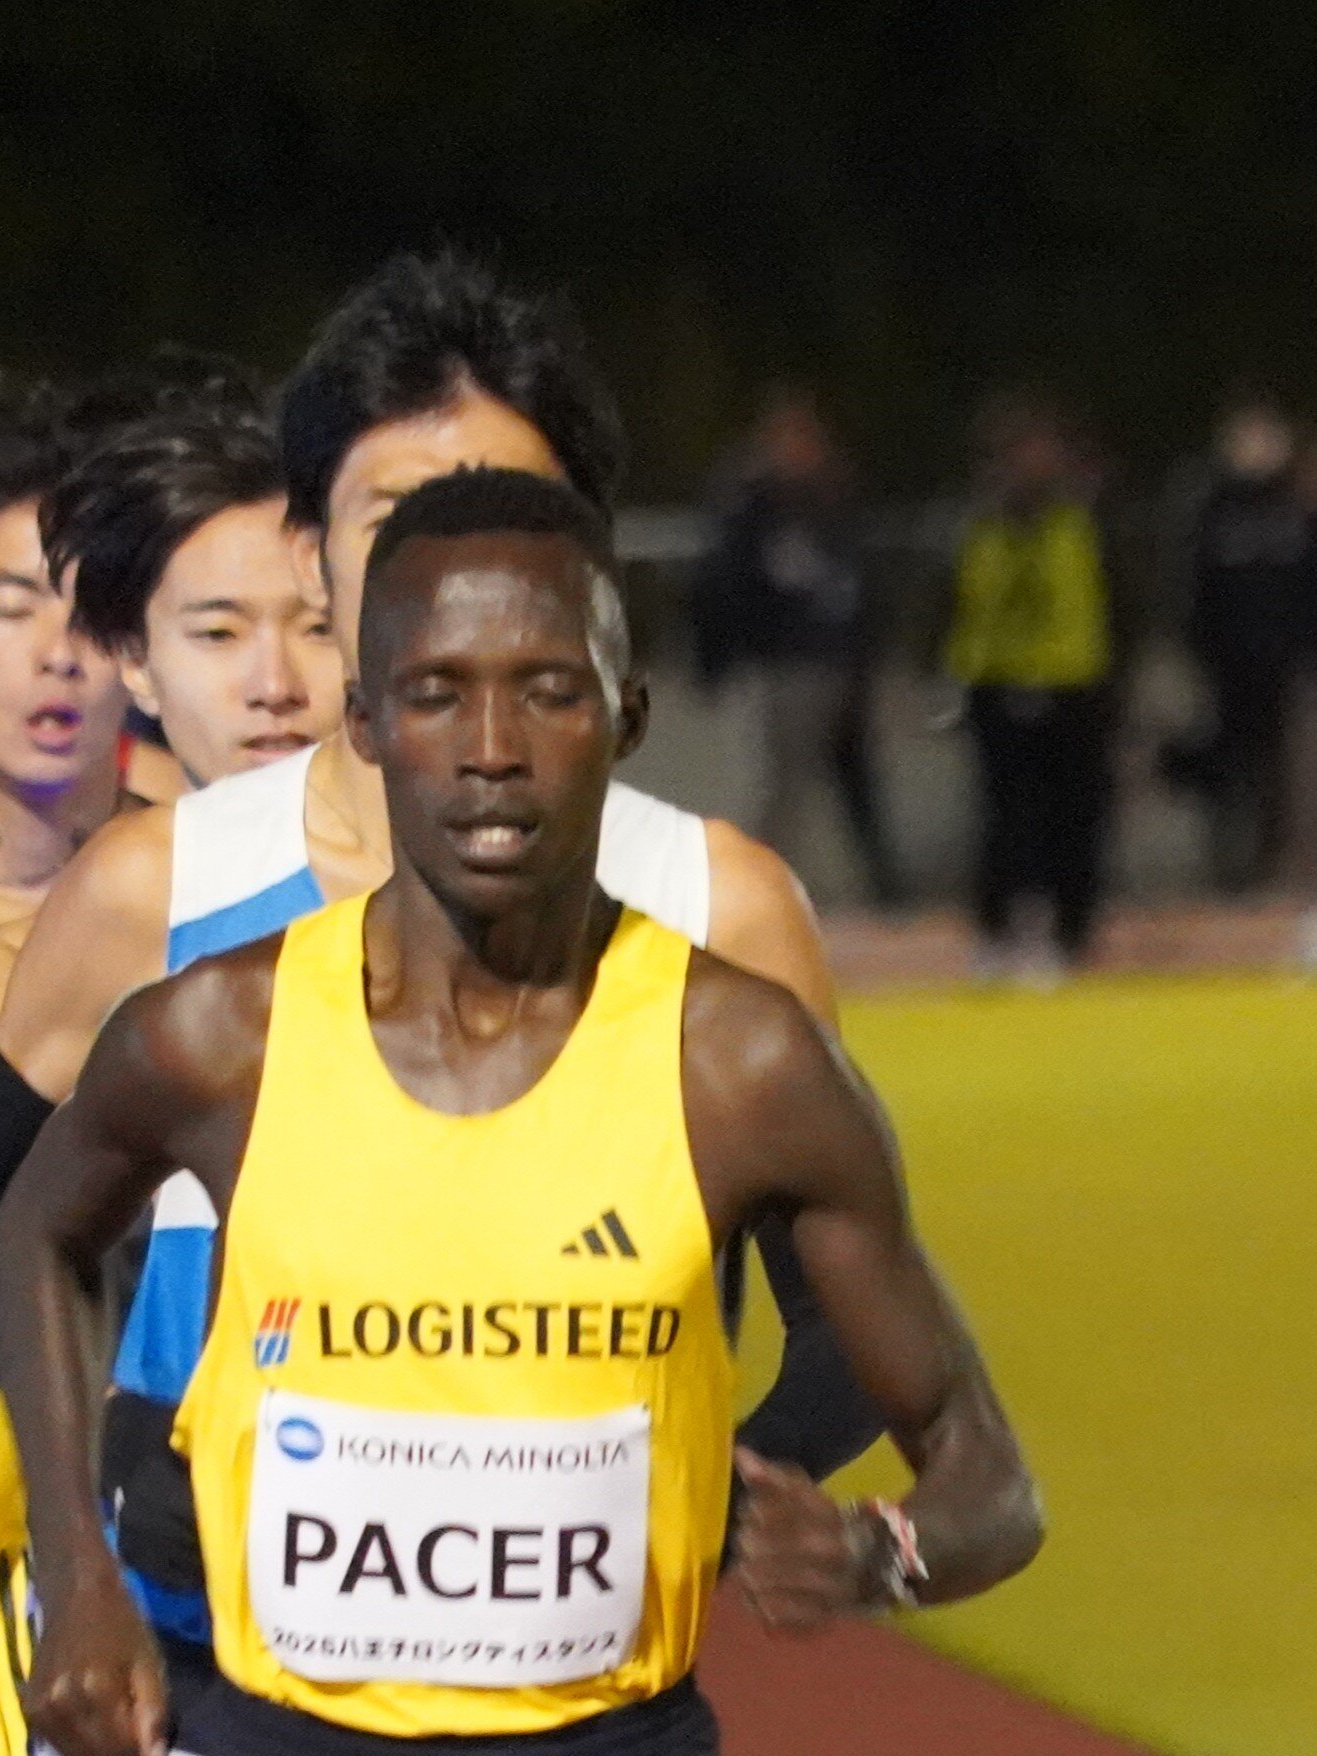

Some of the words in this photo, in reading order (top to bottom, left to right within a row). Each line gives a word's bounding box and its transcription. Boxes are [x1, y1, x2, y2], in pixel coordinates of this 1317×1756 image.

[319, 1301, 682, 1358] LOGISTEED
[338, 1433, 471, 1471] KONICA
[482, 1441, 628, 1471] MINOLTA
[283, 1510, 614, 1601] PACER
